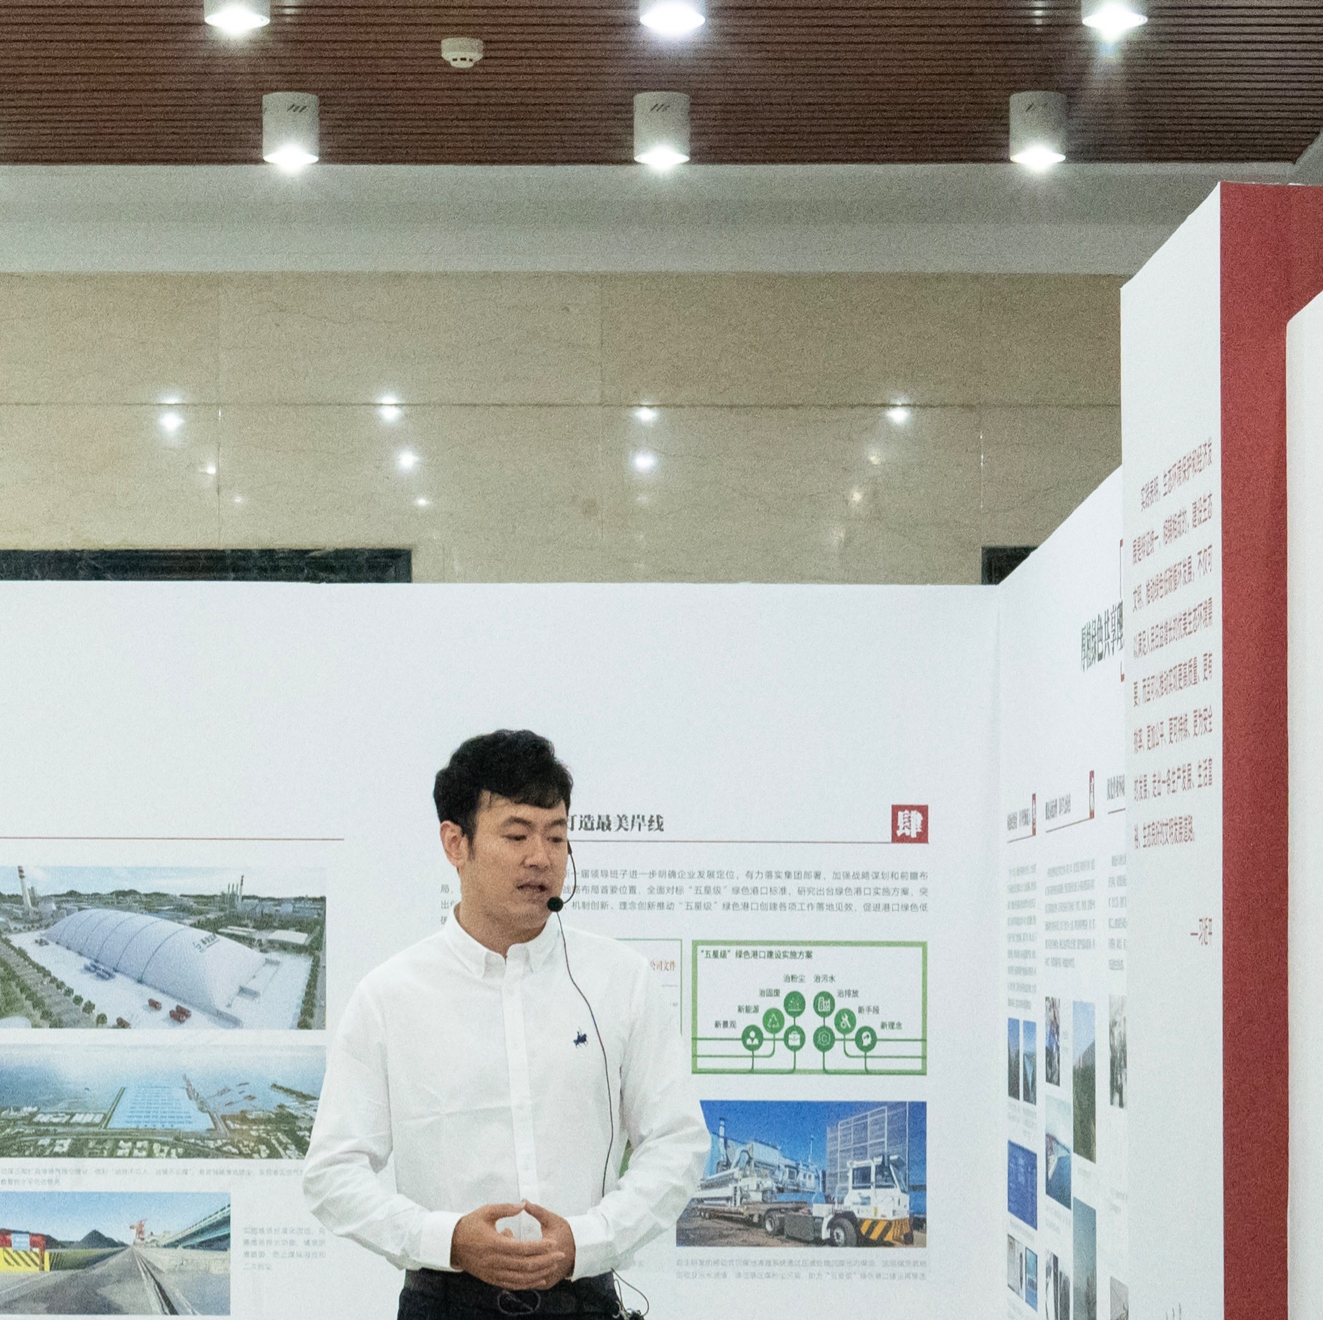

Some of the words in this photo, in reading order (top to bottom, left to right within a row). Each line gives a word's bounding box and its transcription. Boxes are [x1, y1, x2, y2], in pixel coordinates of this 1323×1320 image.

[896, 809, 923, 838] 肆
[566, 869, 929, 881] 一届领导班子进一步明确企业发展定位，有力落实集团部署，加强战略谋划和前瞻布
